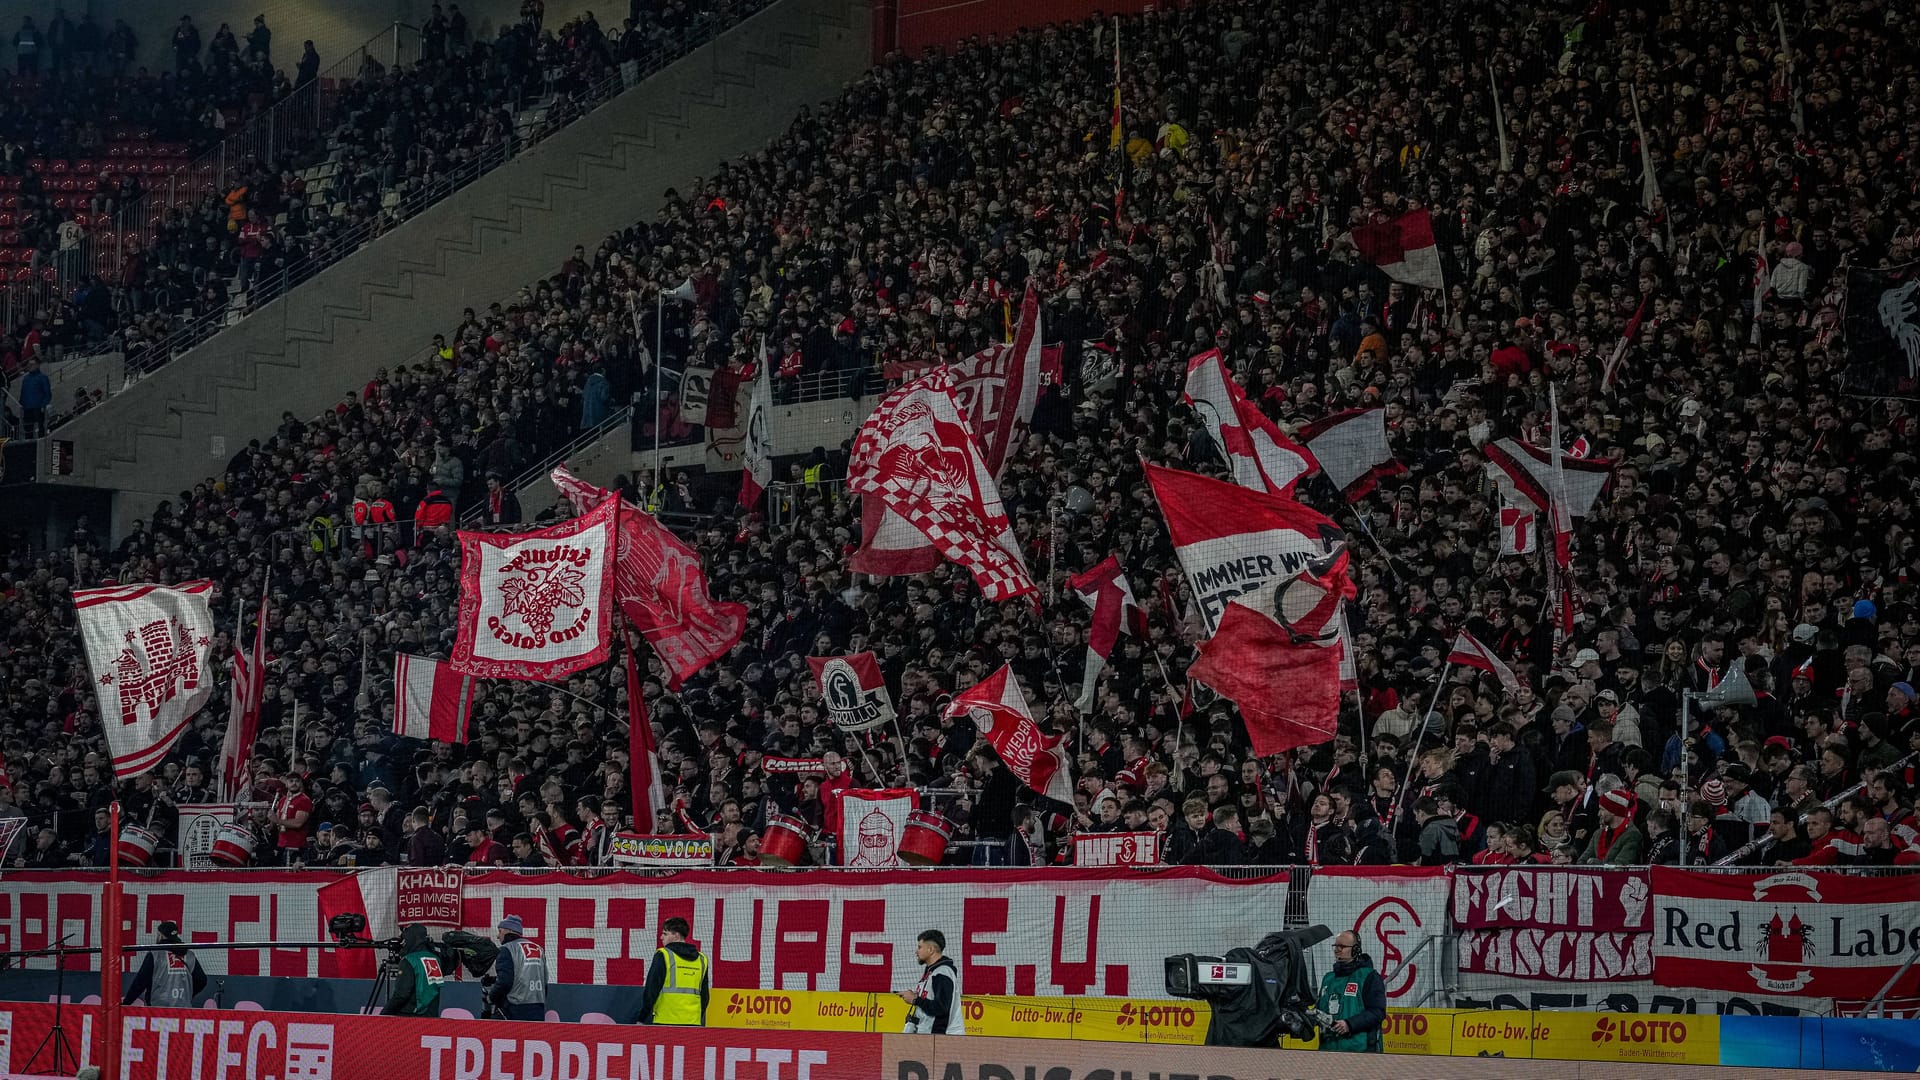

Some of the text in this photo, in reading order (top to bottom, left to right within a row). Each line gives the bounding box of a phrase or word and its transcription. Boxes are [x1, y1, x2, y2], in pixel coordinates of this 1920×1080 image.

[66, 227, 79, 239] 64
[1193, 555, 1277, 594] IMMER
[1002, 719, 1032, 760] WIEDER
[399, 873, 459, 890] KHALID
[399, 891, 459, 905] FÜR IMMER
[1454, 871, 1602, 926] FIGHT
[407, 907, 450, 918] BEI UNS
[1662, 907, 1743, 952] Red
[171, 988, 184, 999] 07
[746, 995, 792, 1014] LOTTO
[817, 1001, 885, 1018] lotto-bw.de
[1011, 1006, 1083, 1023] lotto-bw.de
[1140, 1006, 1195, 1027] LOTTO
[745, 1018, 791, 1029] Baden-Württemberg
[1381, 1014, 1428, 1036] OTTO
[1461, 1020, 1550, 1040] lotto-bw.de
[1620, 1020, 1687, 1044] LOTTO
[1139, 1031, 1194, 1041] Baden-Württemberg
[1619, 1048, 1686, 1059] Baden-Württemberg
